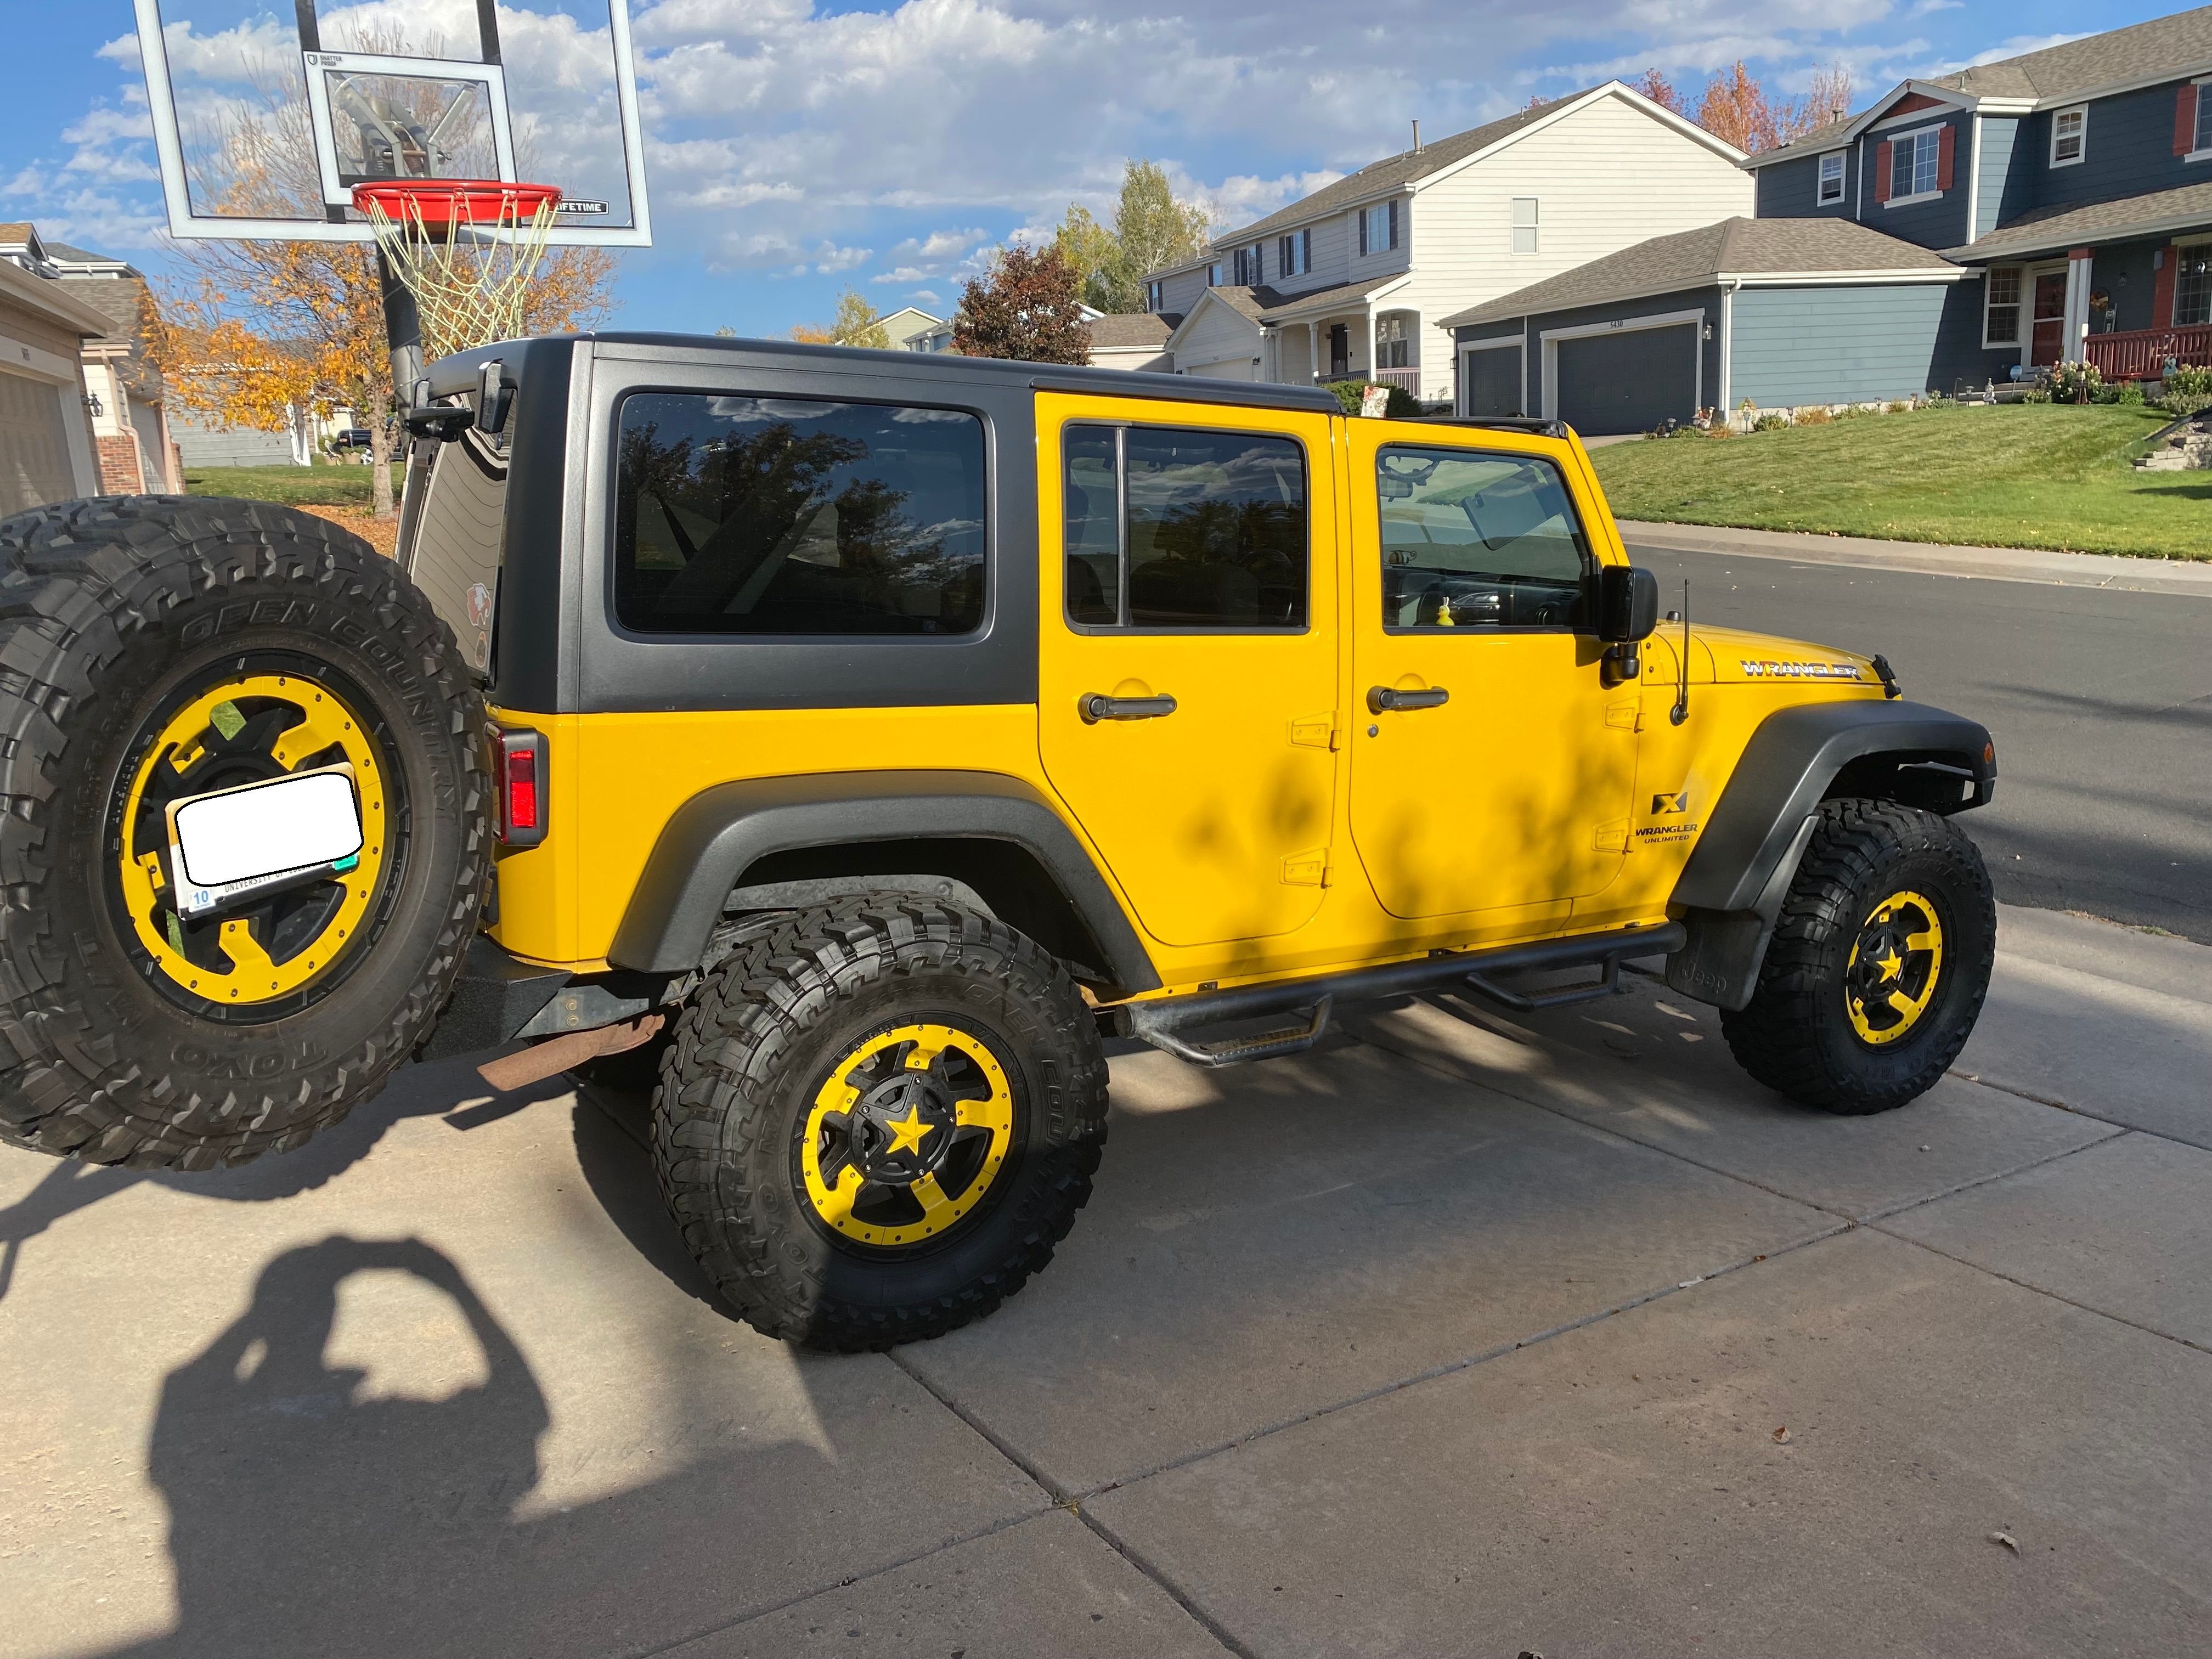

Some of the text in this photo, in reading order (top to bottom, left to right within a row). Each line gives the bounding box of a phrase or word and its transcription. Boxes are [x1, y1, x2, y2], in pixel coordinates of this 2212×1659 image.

[1740, 661, 1862, 681] WRANGLER
[180, 600, 457, 823] OPEN COUNTRY
[1635, 824, 1697, 836] WRANGLER
[1644, 835, 1690, 844] UNLIMITED
[194, 890, 210, 905] 10
[1680, 963, 1726, 996] Jeep
[171, 1041, 328, 1080] TOYO
[964, 984, 1065, 1235] OPEN COUNTRY
[759, 1184, 830, 1285] TOYO
